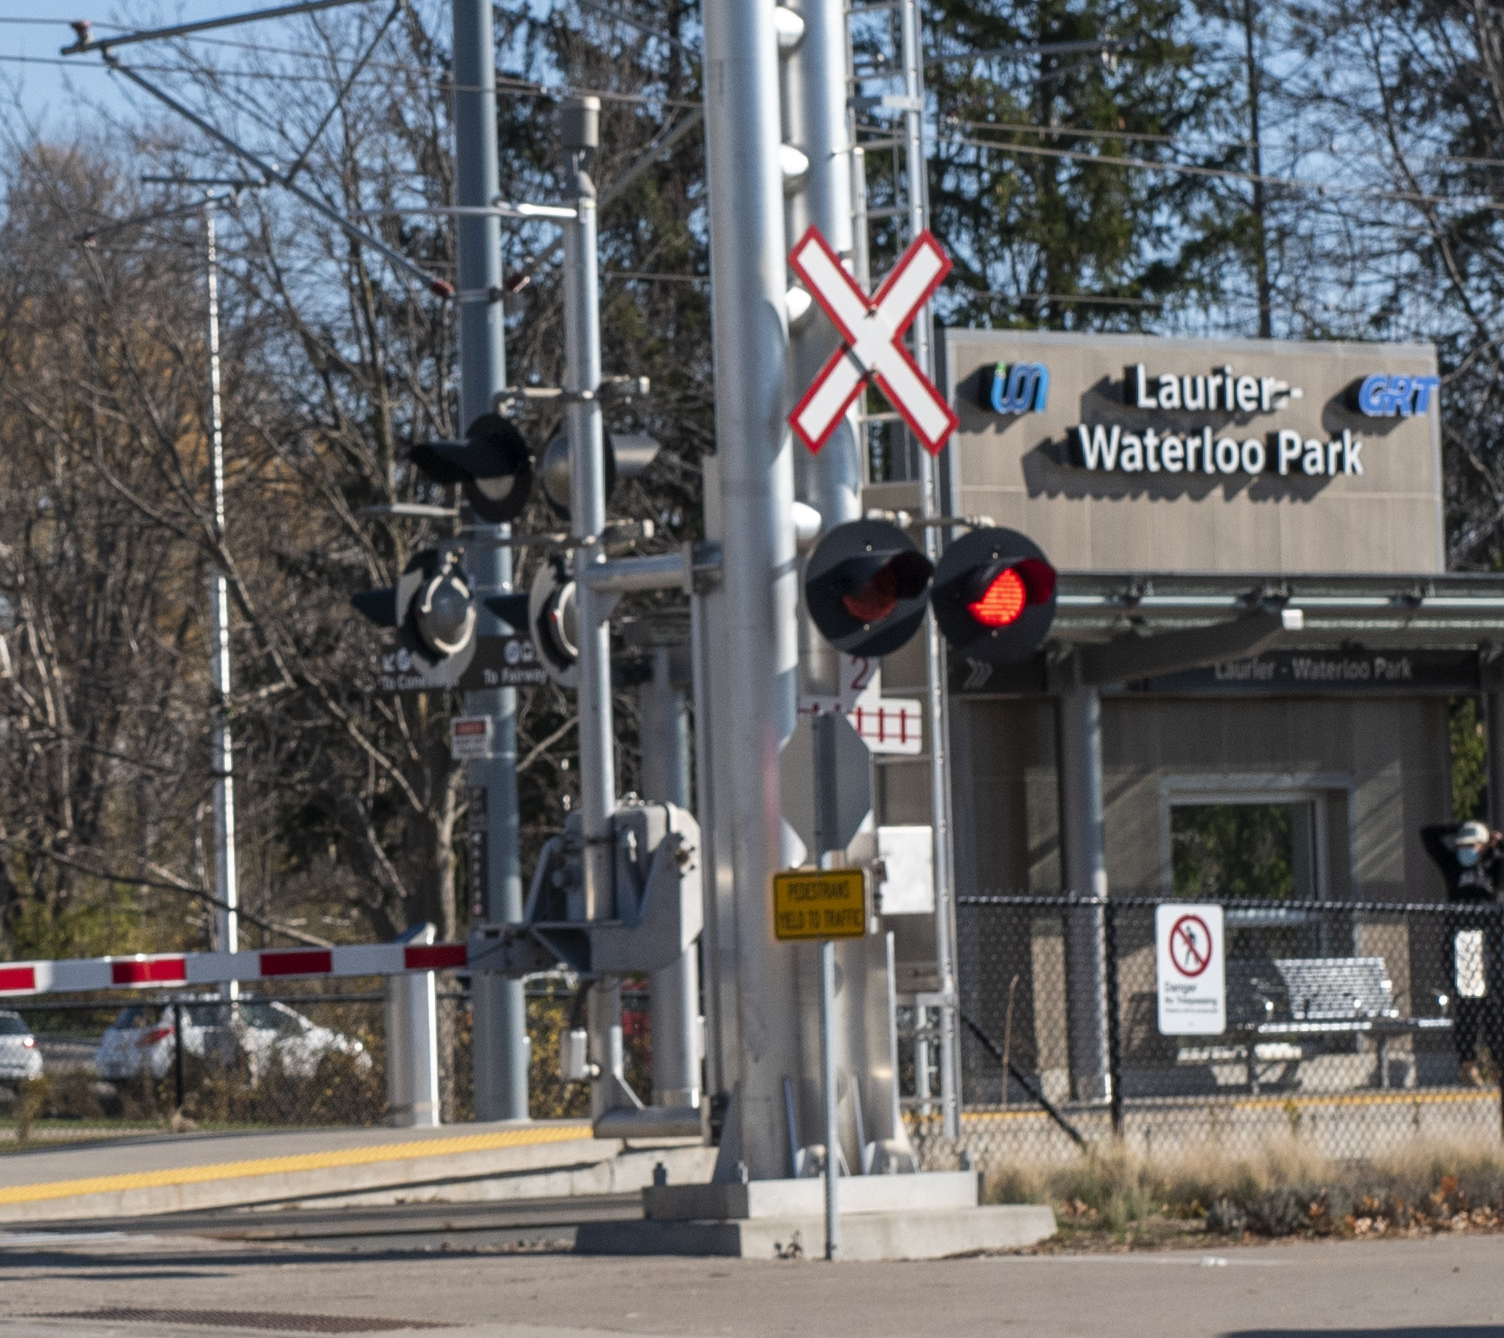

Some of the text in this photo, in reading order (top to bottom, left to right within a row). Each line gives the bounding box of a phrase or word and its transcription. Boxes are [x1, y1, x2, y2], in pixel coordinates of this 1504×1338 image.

[1136, 362, 1304, 412] Laurier-
[1358, 373, 1442, 418] GRT
[1078, 424, 1365, 476] Waterloo Park
[1214, 657, 1276, 680] Laurier
[1292, 657, 1370, 680] Waterloo
[1374, 657, 1412, 680] Park
